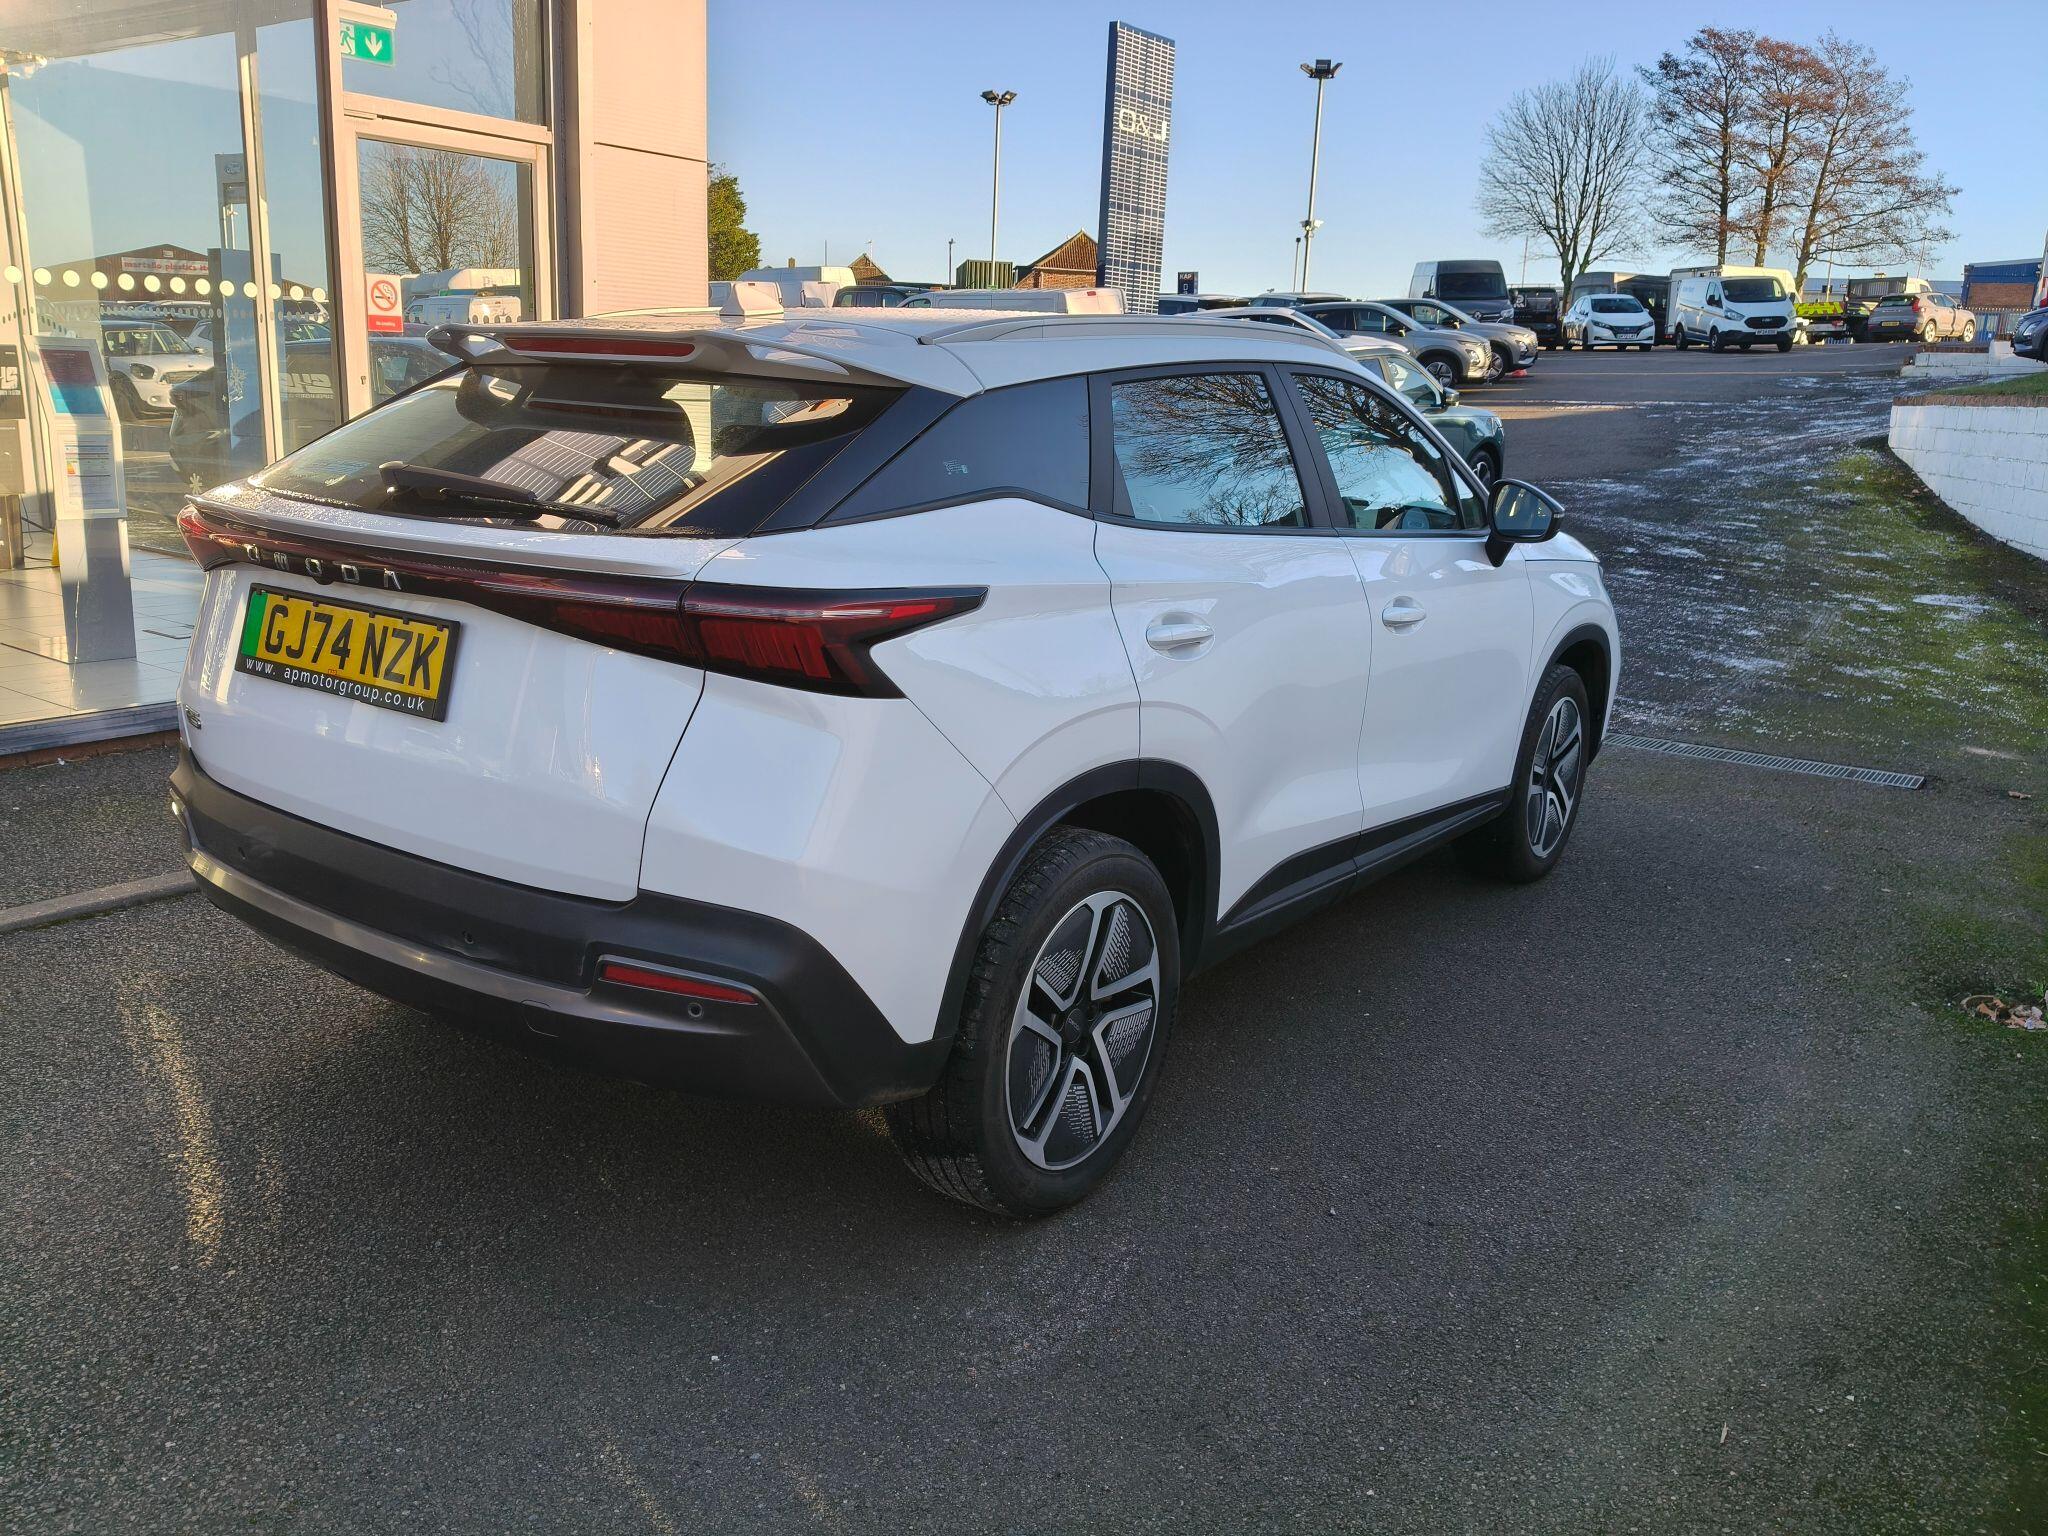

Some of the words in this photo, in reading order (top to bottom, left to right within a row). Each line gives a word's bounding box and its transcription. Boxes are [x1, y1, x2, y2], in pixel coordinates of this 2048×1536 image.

[124, 260, 162, 270] martello
[165, 262, 197, 272] plastics
[243, 543, 401, 590] OMODA
[264, 604, 353, 670] GJ74
[360, 622, 439, 690] NZK
[284, 667, 425, 712] apmotorgroup.co.uk
